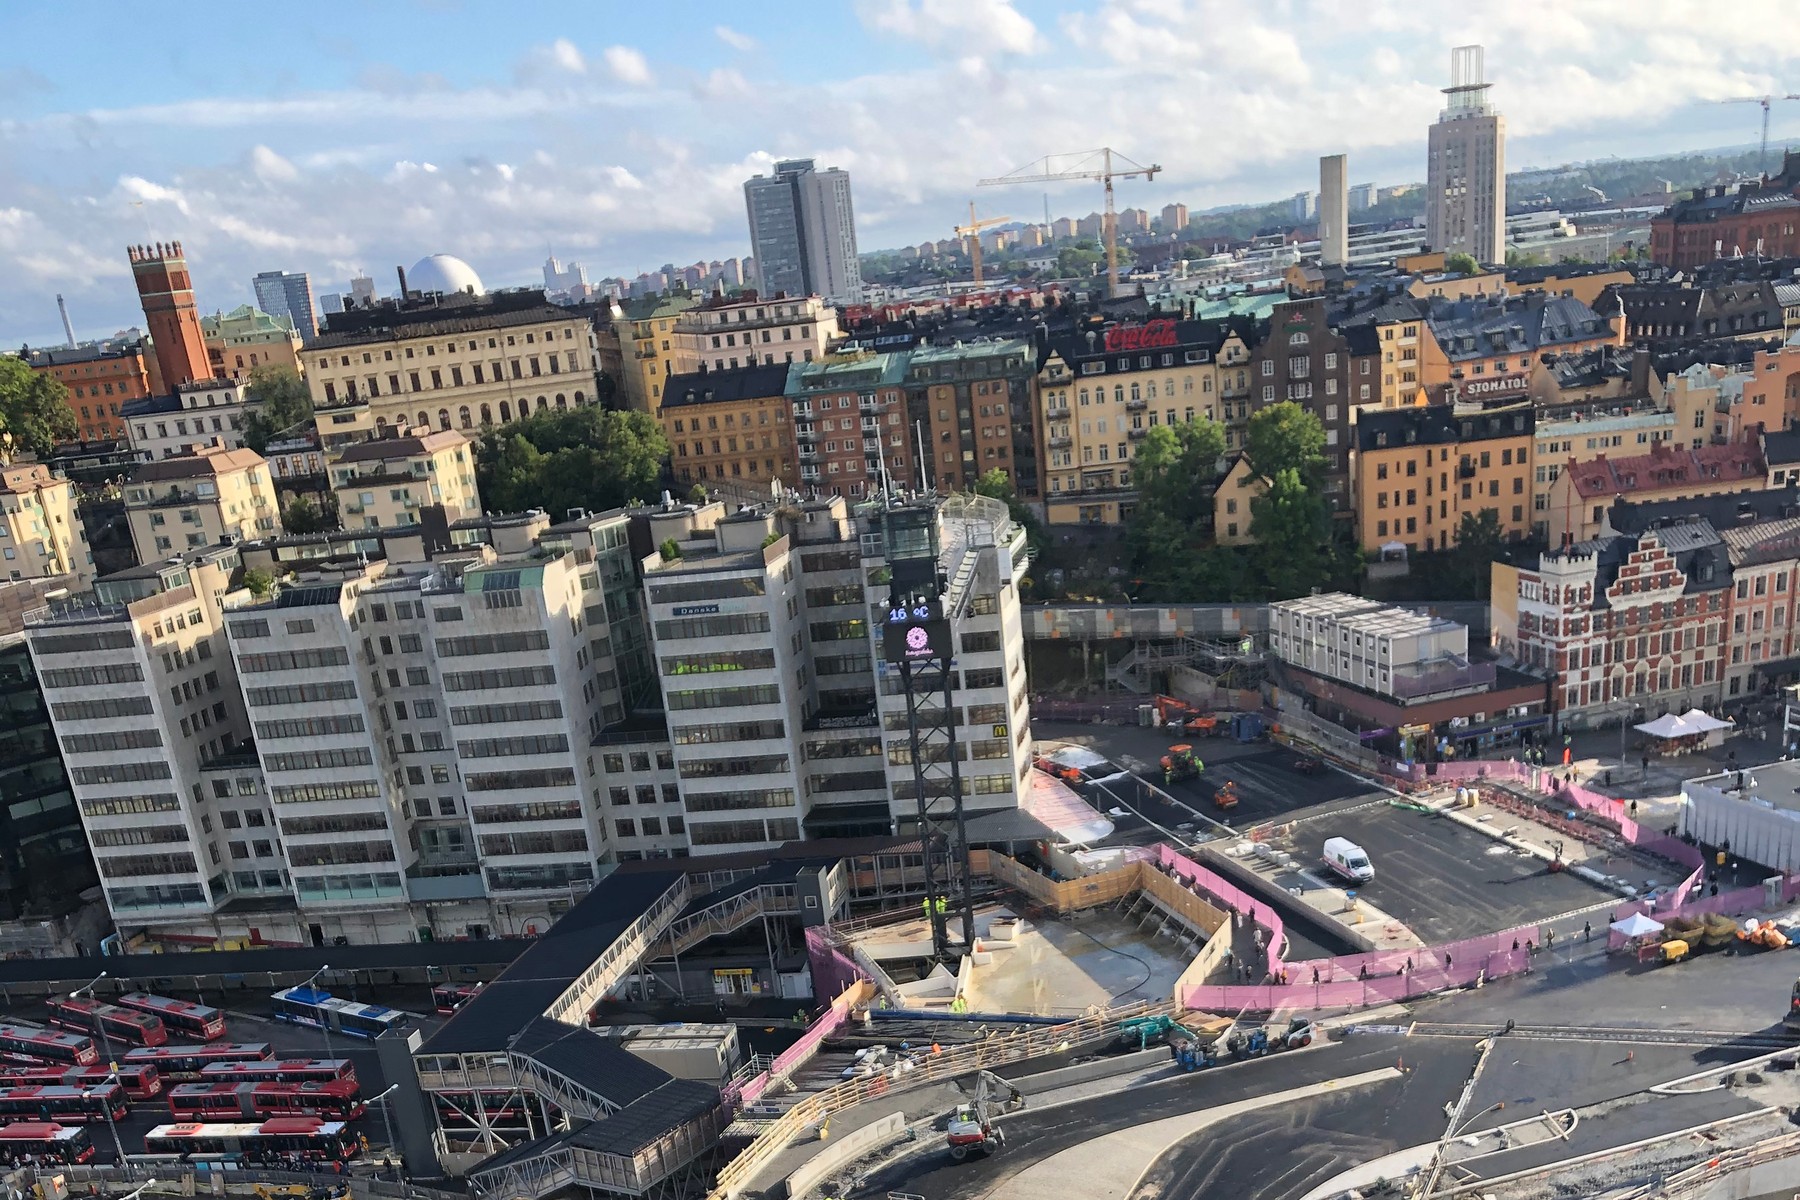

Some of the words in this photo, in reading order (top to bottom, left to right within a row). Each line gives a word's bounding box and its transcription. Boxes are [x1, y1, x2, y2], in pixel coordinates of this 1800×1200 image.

[1467, 378, 1527, 394] STOMATOL
[681, 606, 716, 615] Danske
[889, 607, 907, 621] 16
